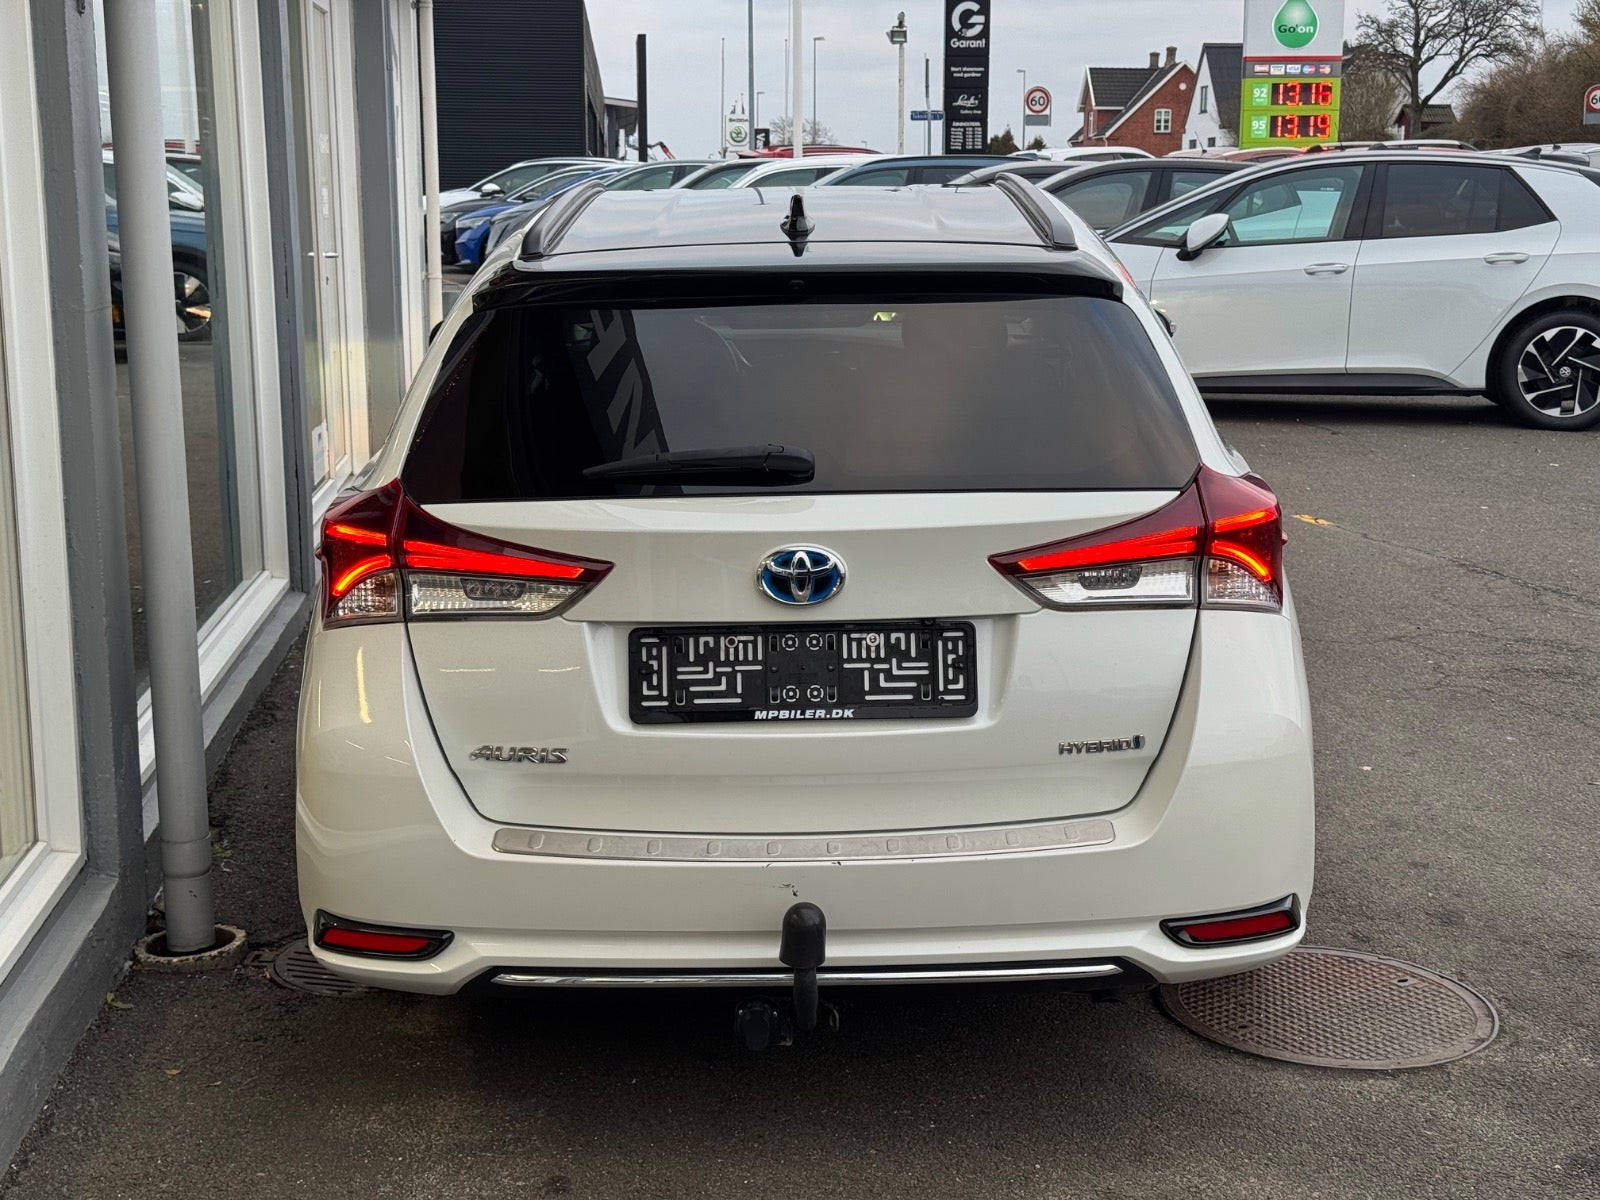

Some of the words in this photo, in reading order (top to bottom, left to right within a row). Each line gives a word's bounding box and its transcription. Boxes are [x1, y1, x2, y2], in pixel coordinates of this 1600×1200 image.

[1278, 24, 1314, 34] Go'on
[950, 38, 986, 48] Garant
[1254, 88, 1268, 97] 92
[1030, 96, 1046, 107] 60
[1591, 94, 1600, 105] 6
[1252, 120, 1266, 130] 95
[754, 708, 855, 720] MPBILER.DK
[1058, 738, 1132, 755] HYBRID
[469, 745, 569, 764] AURIS
